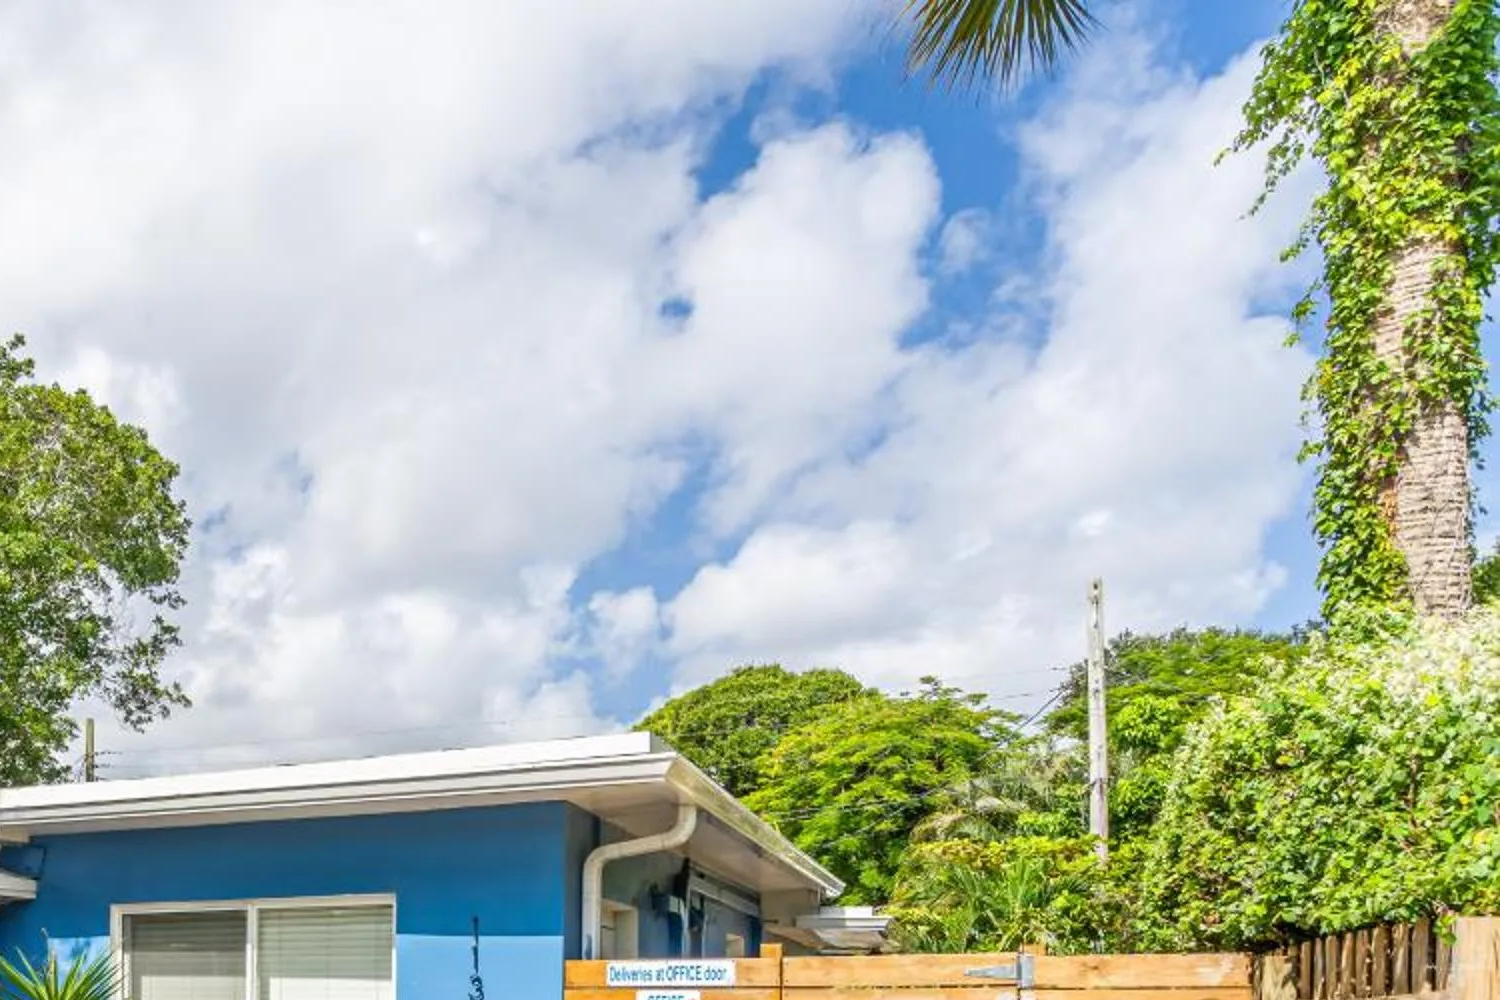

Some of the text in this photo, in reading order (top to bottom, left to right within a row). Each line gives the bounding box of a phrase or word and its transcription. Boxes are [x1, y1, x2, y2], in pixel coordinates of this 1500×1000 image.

[609, 966, 652, 981] Deliveries
[655, 969, 664, 981] at
[666, 965, 702, 981] OFFICE
